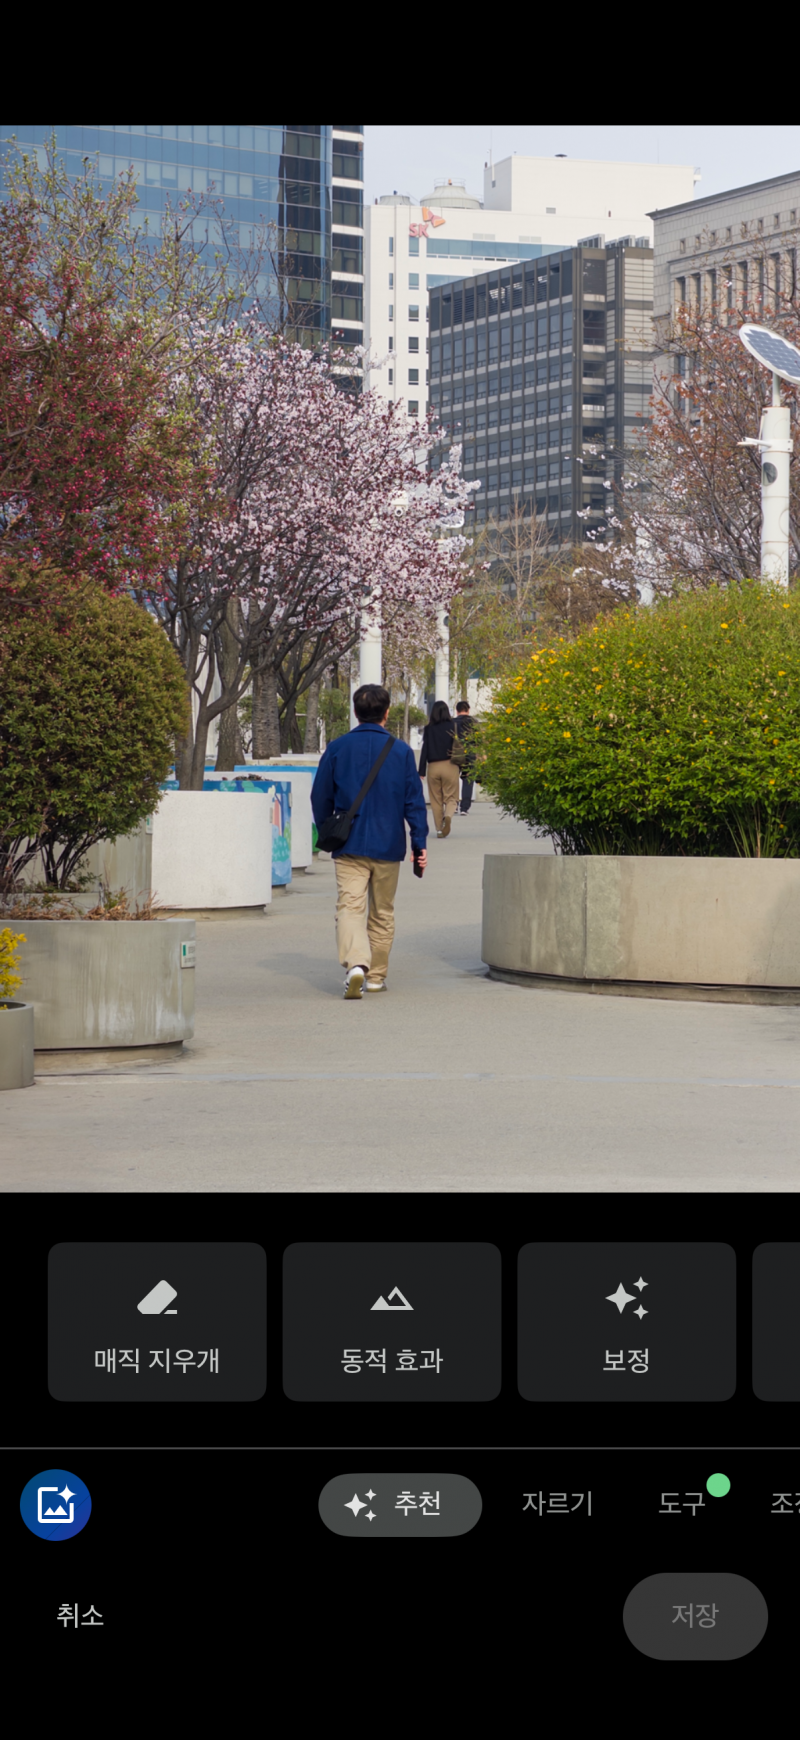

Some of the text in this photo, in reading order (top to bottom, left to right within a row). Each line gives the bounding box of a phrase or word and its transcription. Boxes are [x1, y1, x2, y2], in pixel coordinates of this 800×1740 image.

[409, 222, 429, 238] SK
[95, 1348, 219, 1373] 매직 지우개
[341, 1348, 443, 1373] 동적 효과
[603, 1348, 649, 1373] 보정
[395, 1491, 440, 1516] 추천
[522, 1491, 592, 1516] 자르기
[659, 1492, 705, 1516] 도구
[771, 1492, 800, 1514] 조
[57, 1603, 104, 1628] 취소
[672, 1603, 719, 1628] 저장
